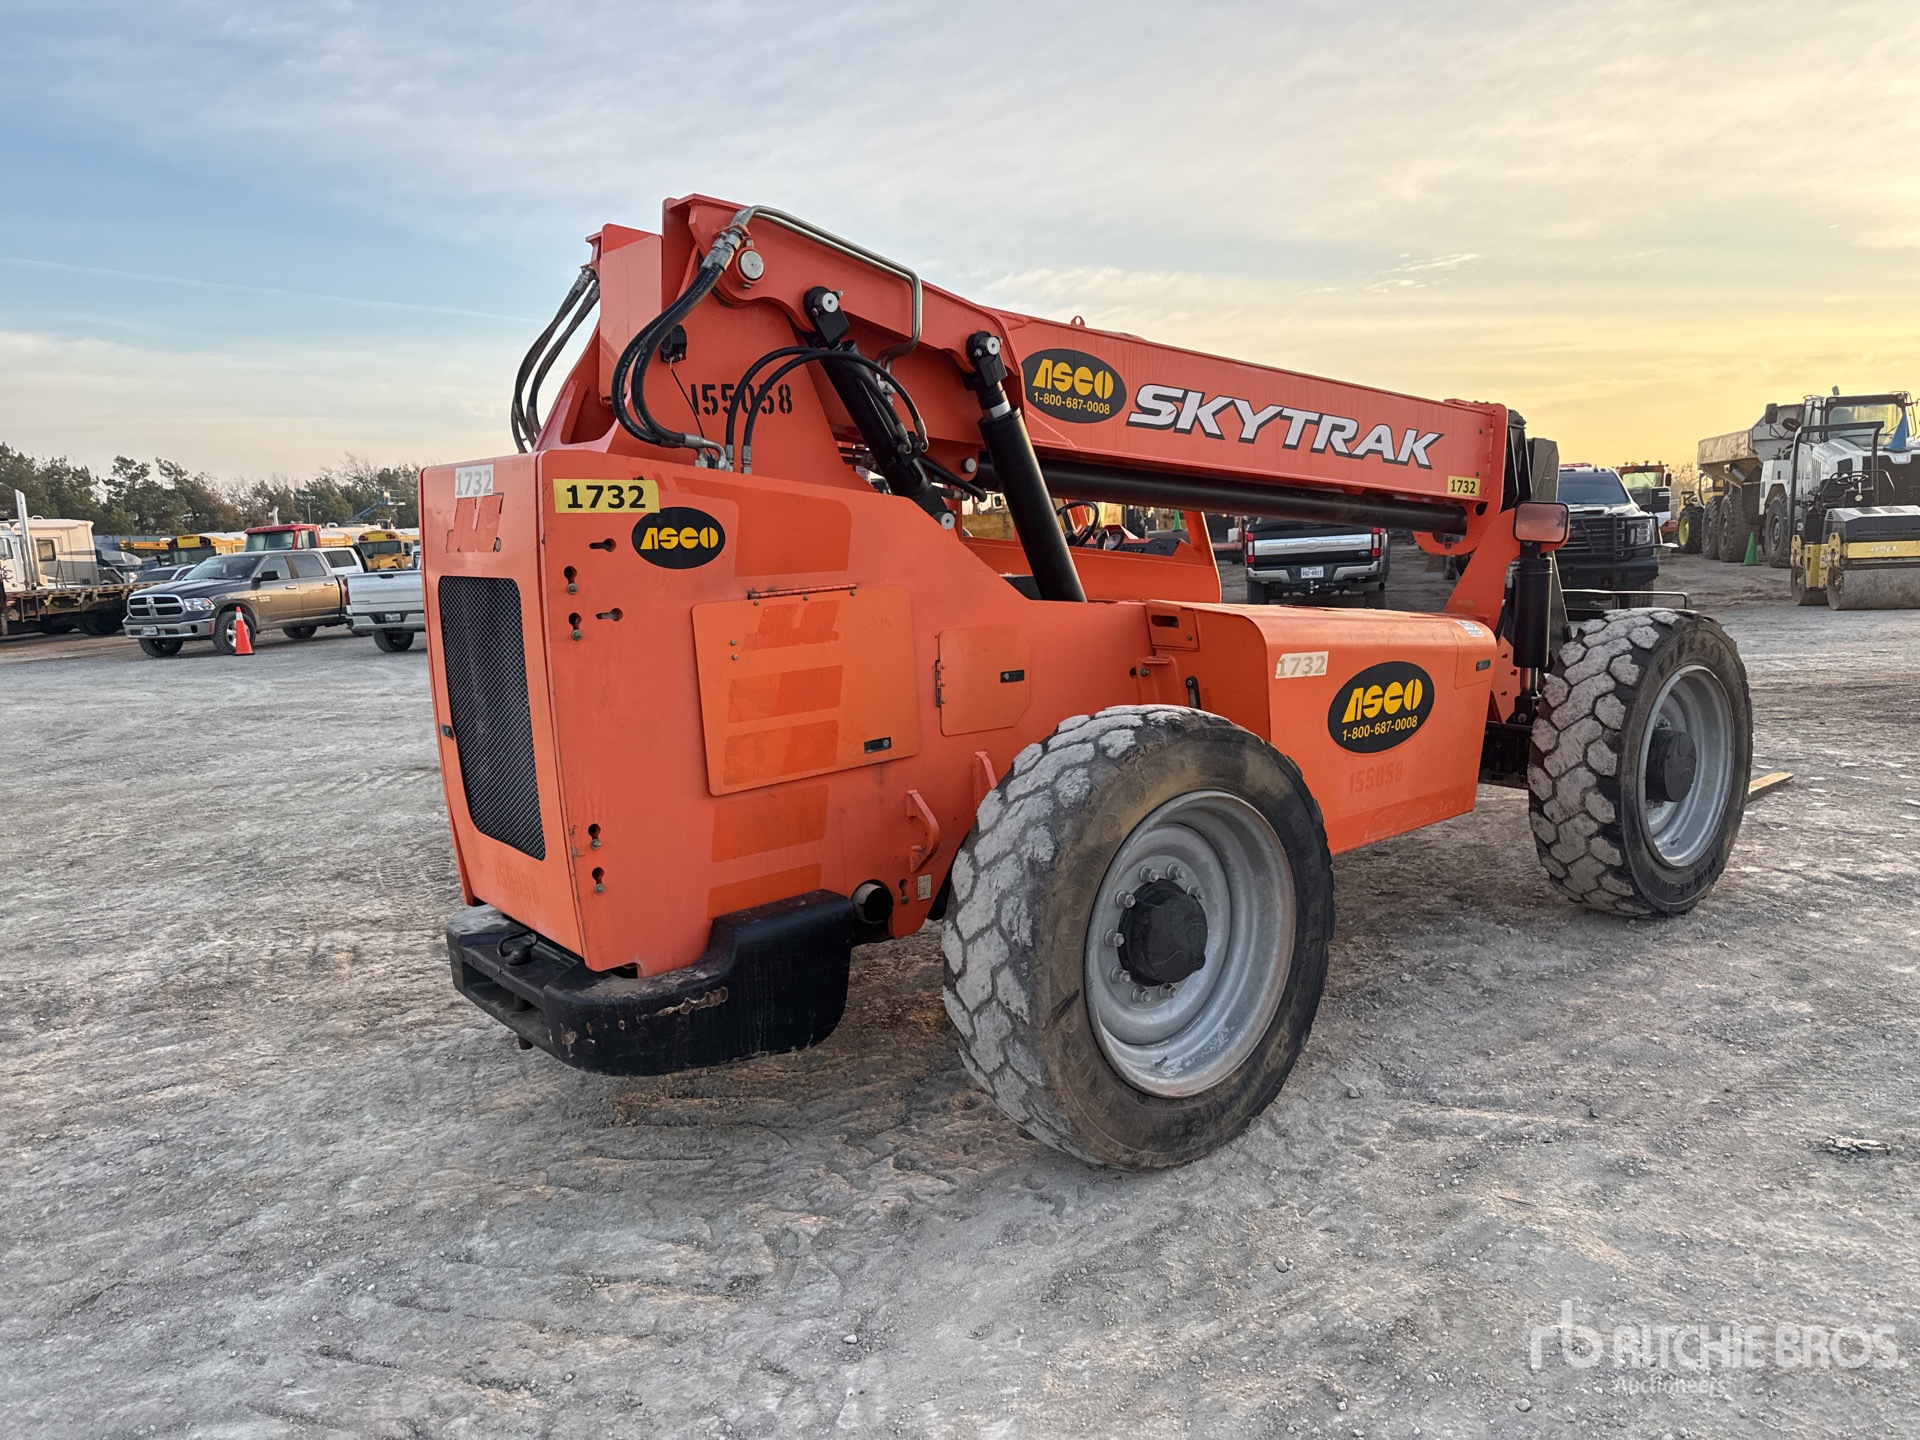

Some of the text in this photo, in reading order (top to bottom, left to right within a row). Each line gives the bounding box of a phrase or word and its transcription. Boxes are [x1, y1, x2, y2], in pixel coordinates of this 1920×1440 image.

[1032, 359, 1114, 399] ASCO
[1034, 391, 1111, 415] 1-800-687-0008
[1126, 383, 1444, 470] SKYTRAK
[456, 469, 492, 496] 1732
[1450, 478, 1476, 495] 1732
[566, 485, 646, 509] 1732
[640, 527, 719, 550] ASCO
[1276, 655, 1326, 677] 1732
[1342, 678, 1423, 723] ASCO
[1342, 716, 1418, 741] 1-800-687-0008
